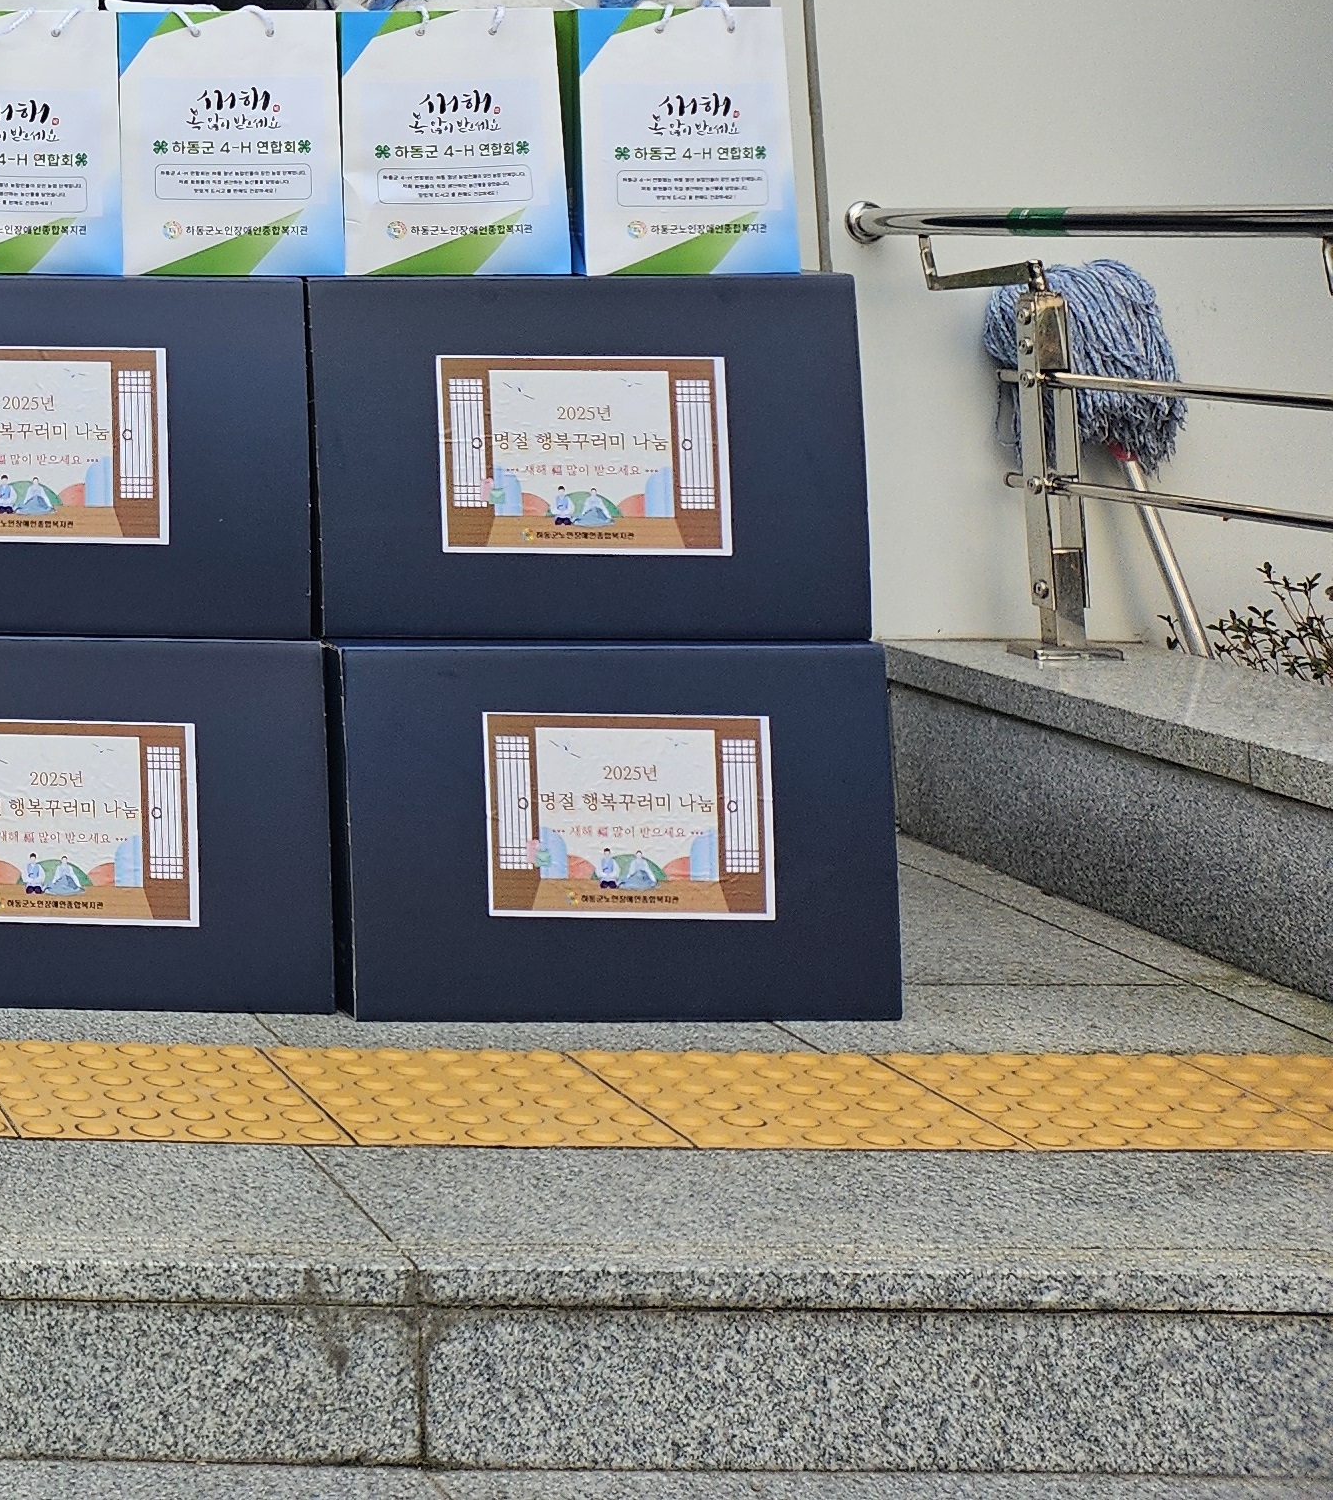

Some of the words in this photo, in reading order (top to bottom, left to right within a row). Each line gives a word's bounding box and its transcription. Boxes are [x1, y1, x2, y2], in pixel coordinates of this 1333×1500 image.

[197, 86, 271, 111] 새해
[420, 89, 492, 114] 새해
[659, 91, 731, 117] 새해
[648, 112, 667, 136] 복
[694, 119, 741, 136] 받으세요
[9, 125, 60, 143] 받으세요
[172, 141, 215, 154] 하동군
[220, 141, 251, 153] 4-H
[256, 140, 296, 154] 연합회
[395, 144, 438, 159] 하동군
[443, 144, 473, 157] 4-H
[478, 142, 516, 157] 연합회
[635, 147, 677, 161] 하동군
[681, 147, 711, 160] 4-H
[717, 146, 755, 160] 연합회
[33, 153, 74, 168] 연합회
[185, 225, 310, 237] 하동군노인장애인종합복지관
[410, 225, 535, 236] 하동군노인장애인종합복지관
[651, 223, 769, 235] 하동군노인장애인종합복지관
[2, 394, 55, 411] 2025년
[556, 405, 611, 421] 2025년
[76, 423, 109, 441] 나눔
[494, 432, 528, 450] 명절
[535, 432, 625, 451] 행복꾸러미
[633, 434, 668, 451] 나눔
[29, 770, 83, 787] 2025년
[603, 764, 657, 781] 2025년
[8, 798, 96, 818] 행복꾸러미
[104, 801, 138, 819] 나눔
[540, 792, 575, 811] 명절
[582, 793, 671, 812] 행복꾸러미
[679, 795, 714, 813] 나눔
